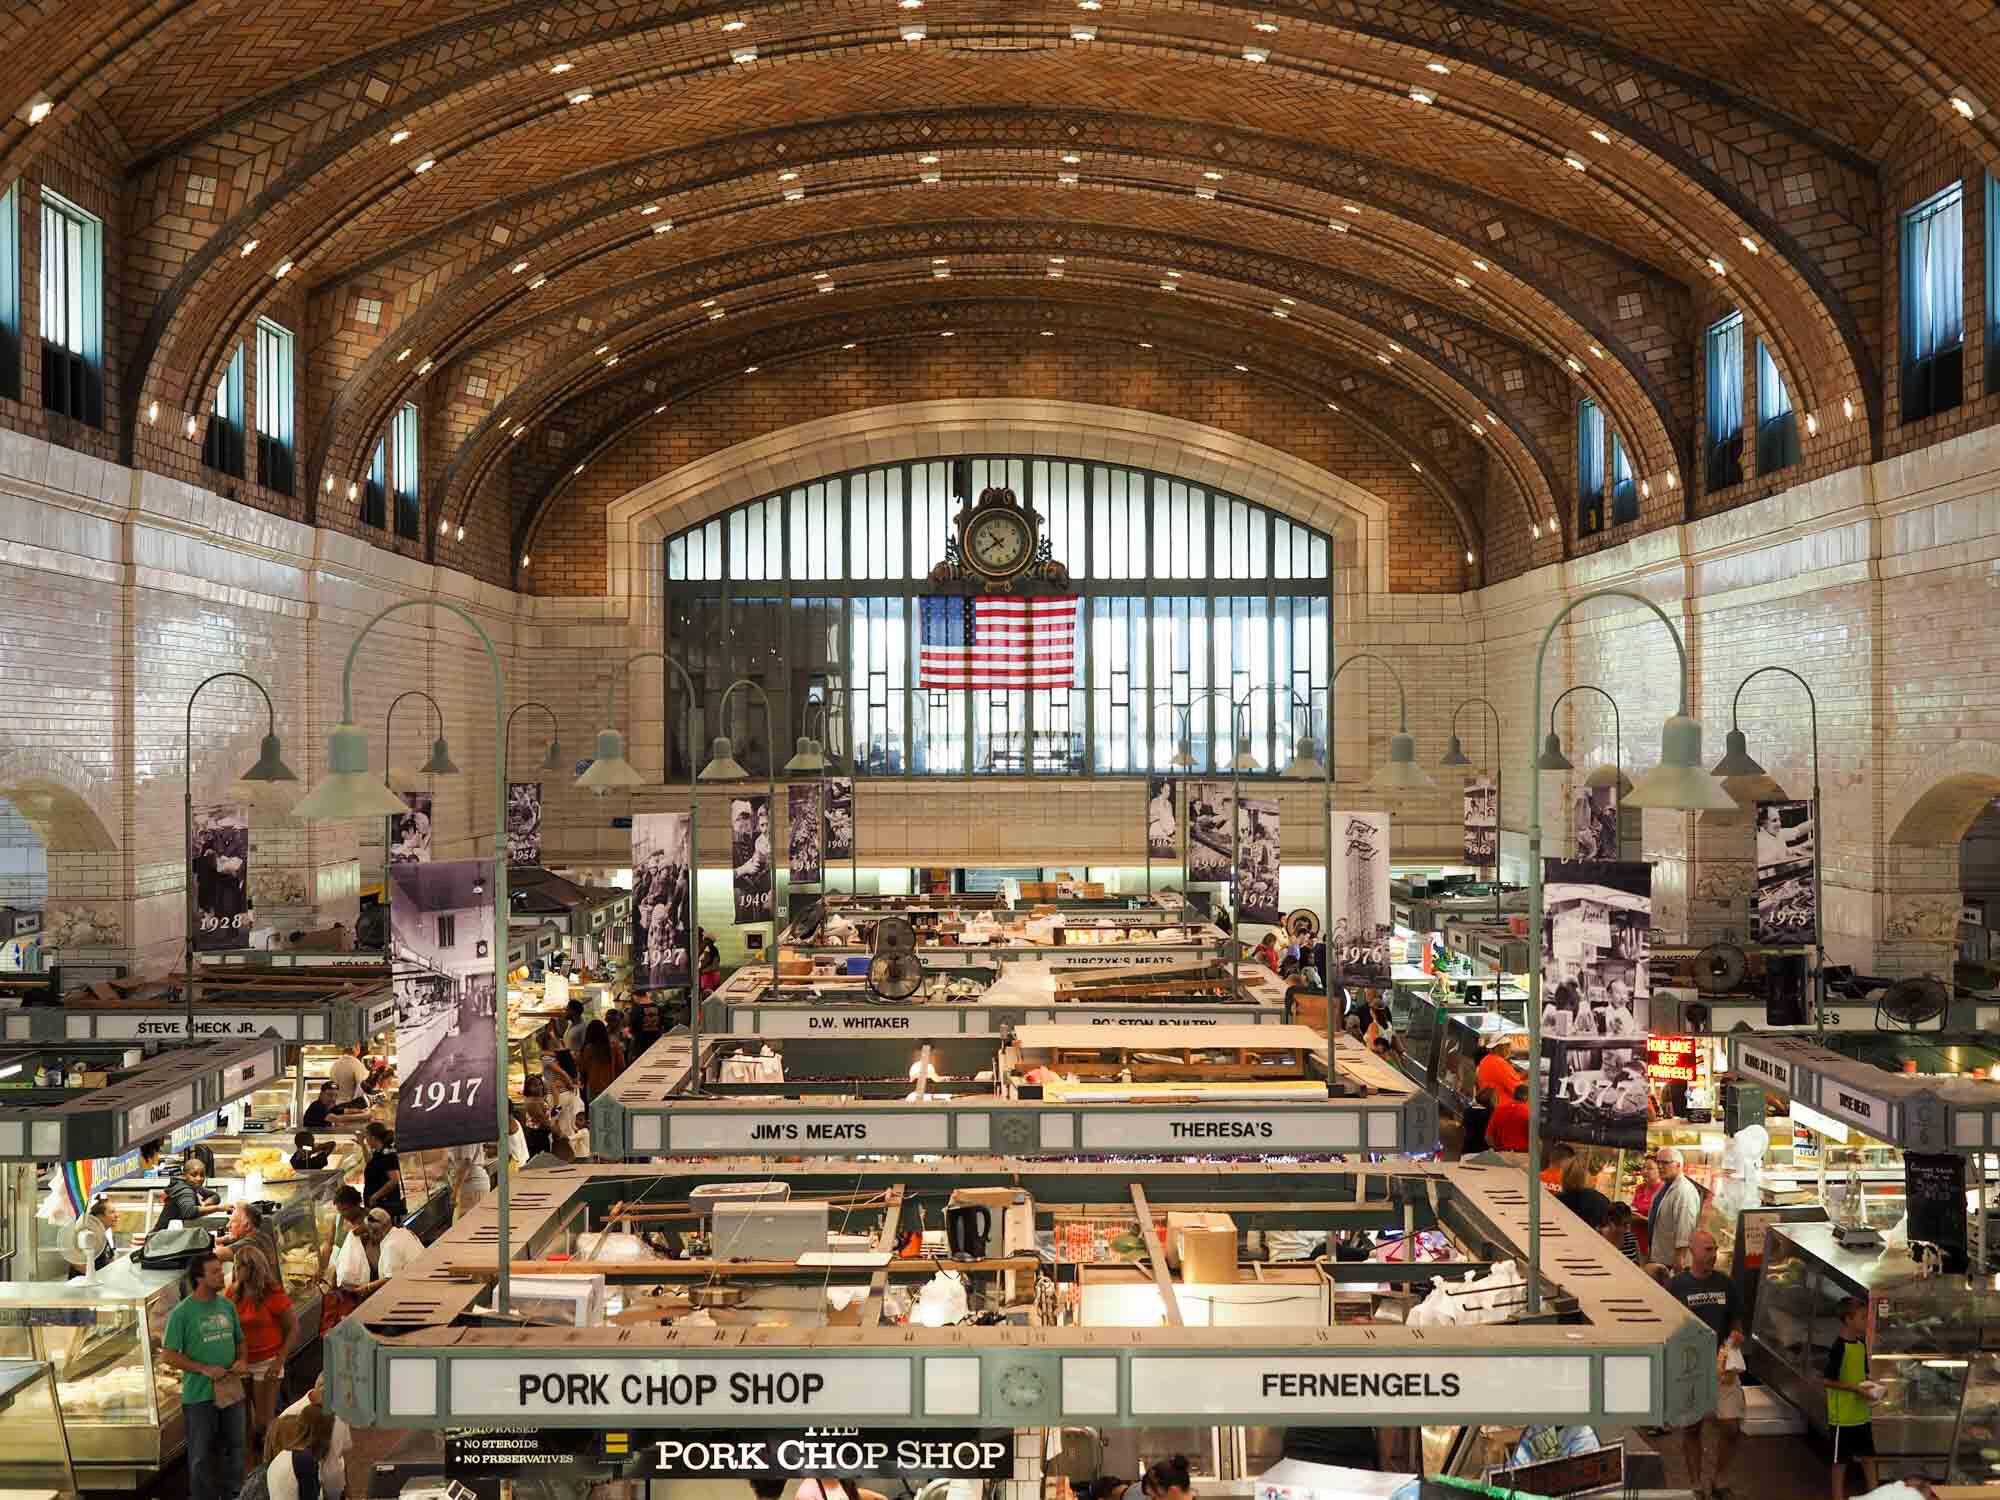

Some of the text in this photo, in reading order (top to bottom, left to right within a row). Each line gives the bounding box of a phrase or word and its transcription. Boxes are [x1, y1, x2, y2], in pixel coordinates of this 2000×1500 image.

[740, 892, 769, 908] 1940
[1241, 891, 1274, 908] 1972
[200, 914, 242, 932] 1928
[641, 948, 686, 968] 1927
[1342, 945, 1383, 965] 1976
[138, 1022, 179, 1034] STEVE
[237, 1022, 257, 1034] JR.
[809, 1017, 909, 1029] D.W. WHITAKER
[411, 1077, 483, 1112] 1917
[751, 1123, 867, 1139] JIM'S MEATS
[1169, 1121, 1273, 1138] THERESA'S
[519, 1371, 824, 1406] PORK CHOP SHOP
[1262, 1373, 1460, 1397] FERNENGELS
[463, 1439, 538, 1449] NO STEROIDS
[463, 1454, 574, 1464] NO PRESERVATIVES
[656, 1439, 1006, 1471] PORK CHOP SHOP
